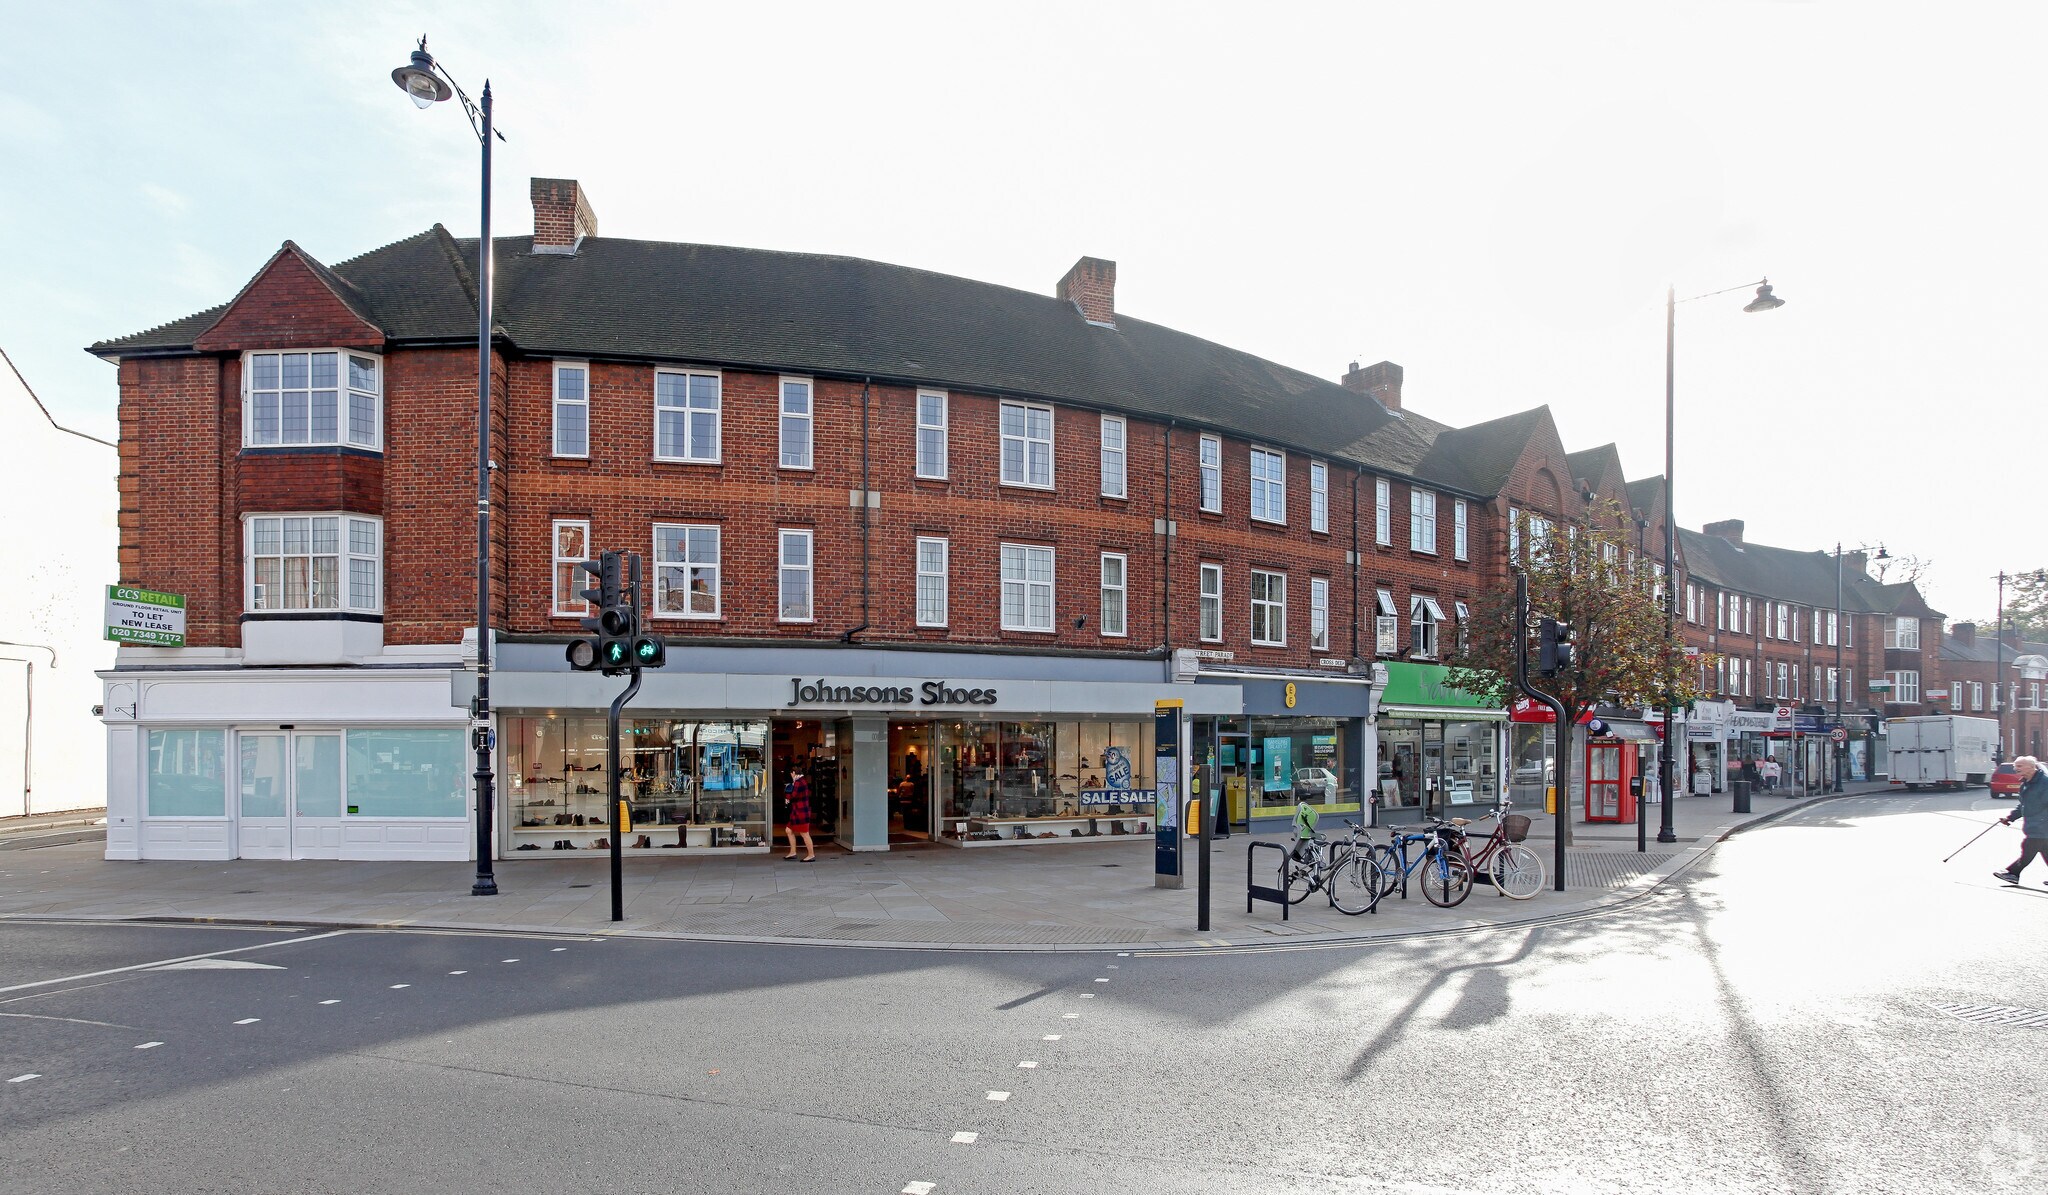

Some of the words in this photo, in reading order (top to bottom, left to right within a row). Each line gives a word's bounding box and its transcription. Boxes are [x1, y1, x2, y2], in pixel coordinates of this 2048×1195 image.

[132, 611, 144, 619] TO
[147, 613, 164, 621] LET
[121, 619, 142, 627] NEW
[145, 622, 173, 630] LEASE
[111, 628, 131, 636] 020
[133, 630, 156, 639] 7349
[159, 633, 181, 642] 7172
[788, 678, 914, 706] Johnsons
[920, 680, 998, 705] Shoes
[1108, 766, 1129, 784] SALE
[1082, 792, 1118, 804] SALE
[1120, 791, 1155, 803] SALE
